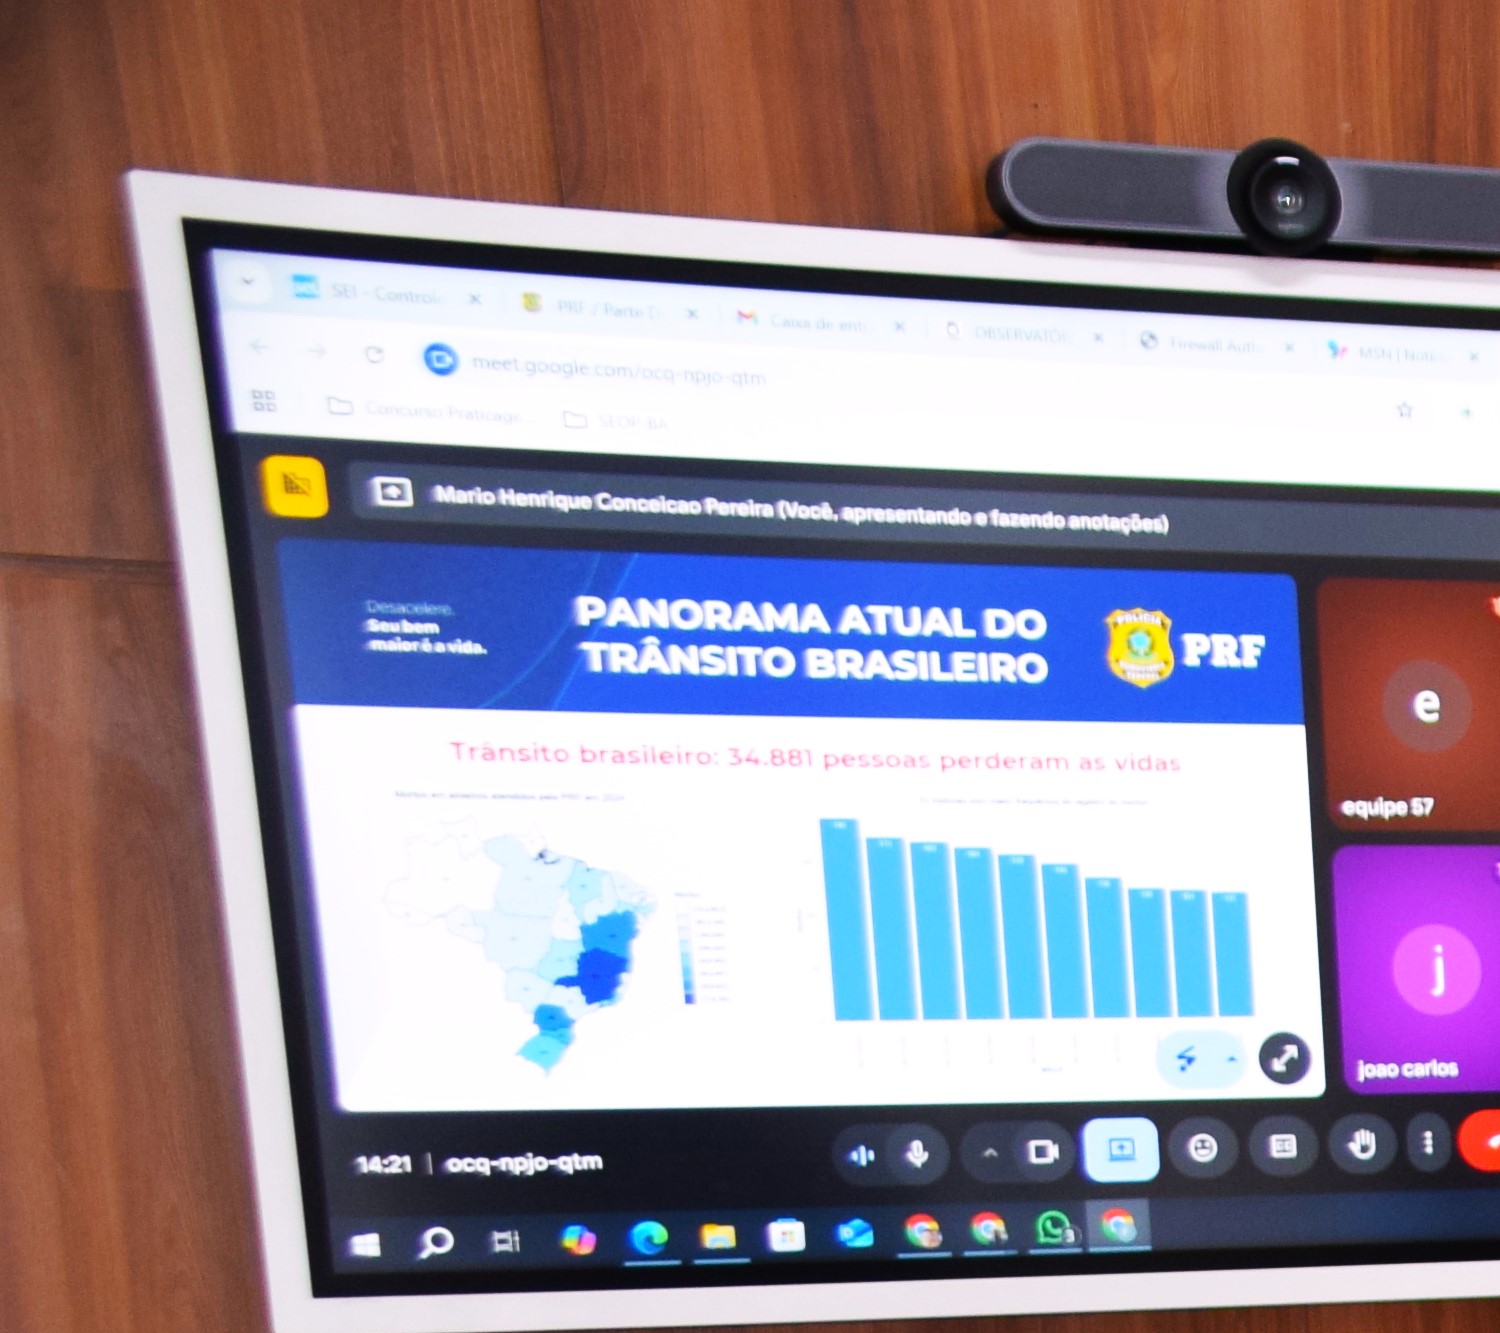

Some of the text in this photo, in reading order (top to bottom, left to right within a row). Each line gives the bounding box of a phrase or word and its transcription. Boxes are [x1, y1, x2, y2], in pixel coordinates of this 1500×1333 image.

[771, 314, 811, 330] Caixa
[816, 316, 834, 331] de
[433, 484, 495, 507] Mario
[498, 487, 592, 513] Henrique
[595, 492, 701, 516] Conceicao
[705, 496, 774, 519] Pereira
[841, 504, 971, 529] apresentando
[975, 512, 988, 527] e
[990, 507, 1065, 530] fazendo
[1067, 512, 1170, 537] anotações)
[365, 618, 440, 636] Seu bem
[576, 594, 1047, 641] PANORAMA ATUAL DO
[580, 636, 1049, 685] TRÂNSITO BRASILEIRO
[1180, 631, 1266, 669] PRF
[1412, 688, 1441, 723] e
[450, 740, 1181, 774] Trânsito brasileiro: 34.881 pessoas perderam as vidas
[1340, 797, 1408, 821] equipe
[1430, 944, 1447, 996] j
[1356, 1058, 1459, 1083] joao carlos
[354, 1154, 412, 1174] 14:21
[444, 1152, 603, 1177] ocq-npjo-qtm
